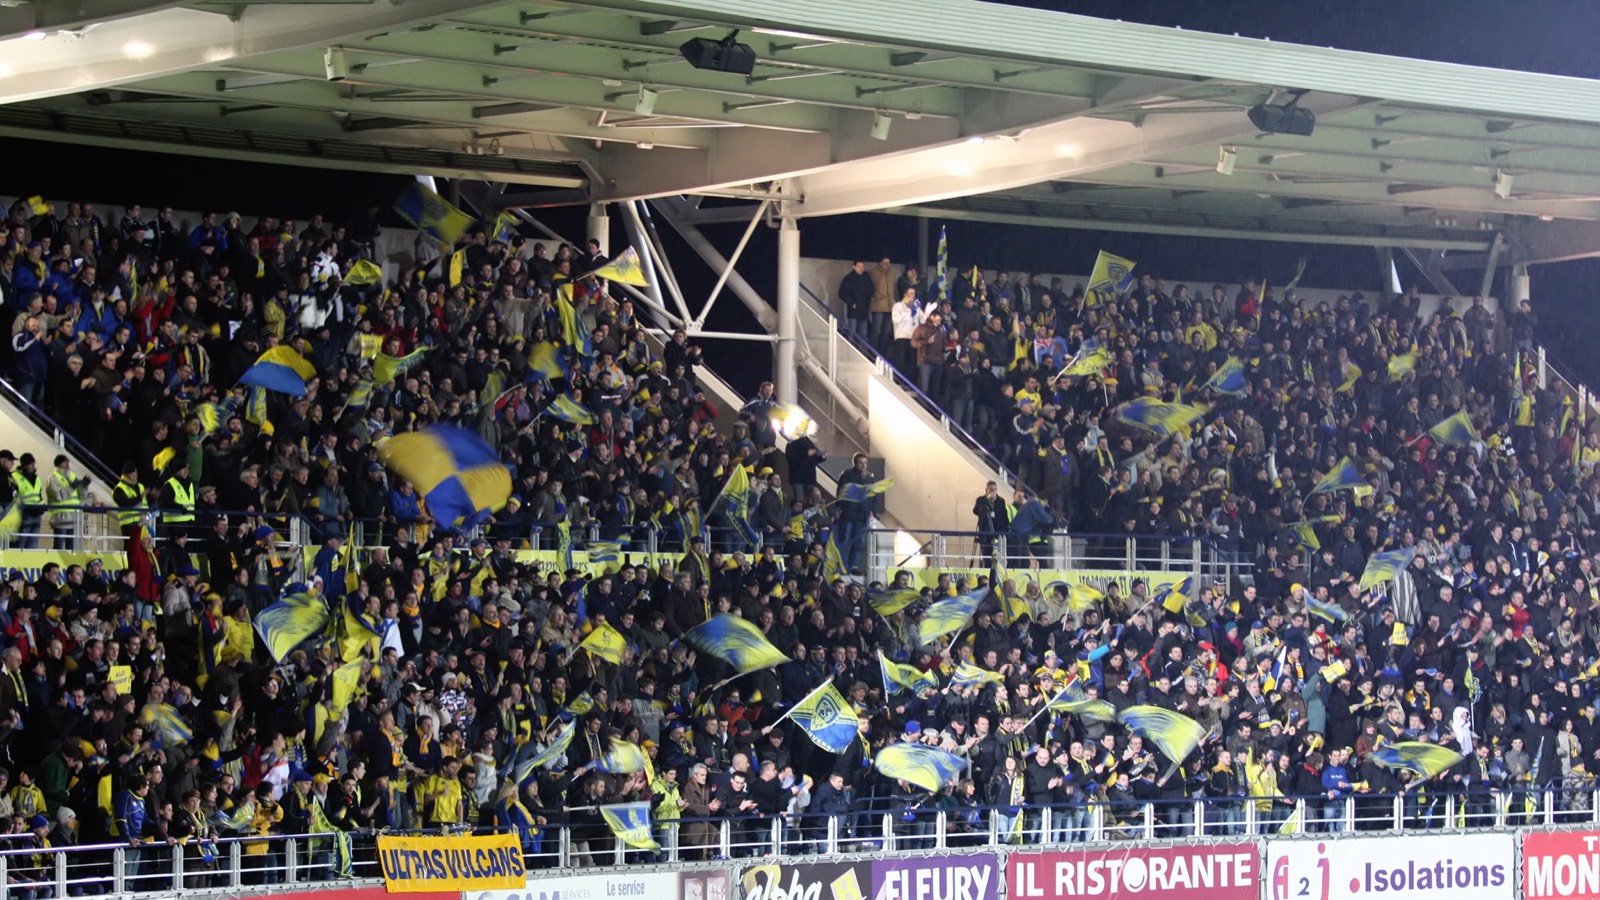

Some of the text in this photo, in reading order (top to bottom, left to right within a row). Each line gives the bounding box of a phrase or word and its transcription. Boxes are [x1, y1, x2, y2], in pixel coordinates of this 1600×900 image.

[382, 846, 524, 880] ULTRAS VULCANS
[1016, 853, 1252, 897] IL RISTORANTE
[1365, 859, 1505, 892] Isolations
[562, 889, 591, 900] SERVICES
[606, 880, 646, 896] Le service
[886, 864, 991, 900] FLEURY
